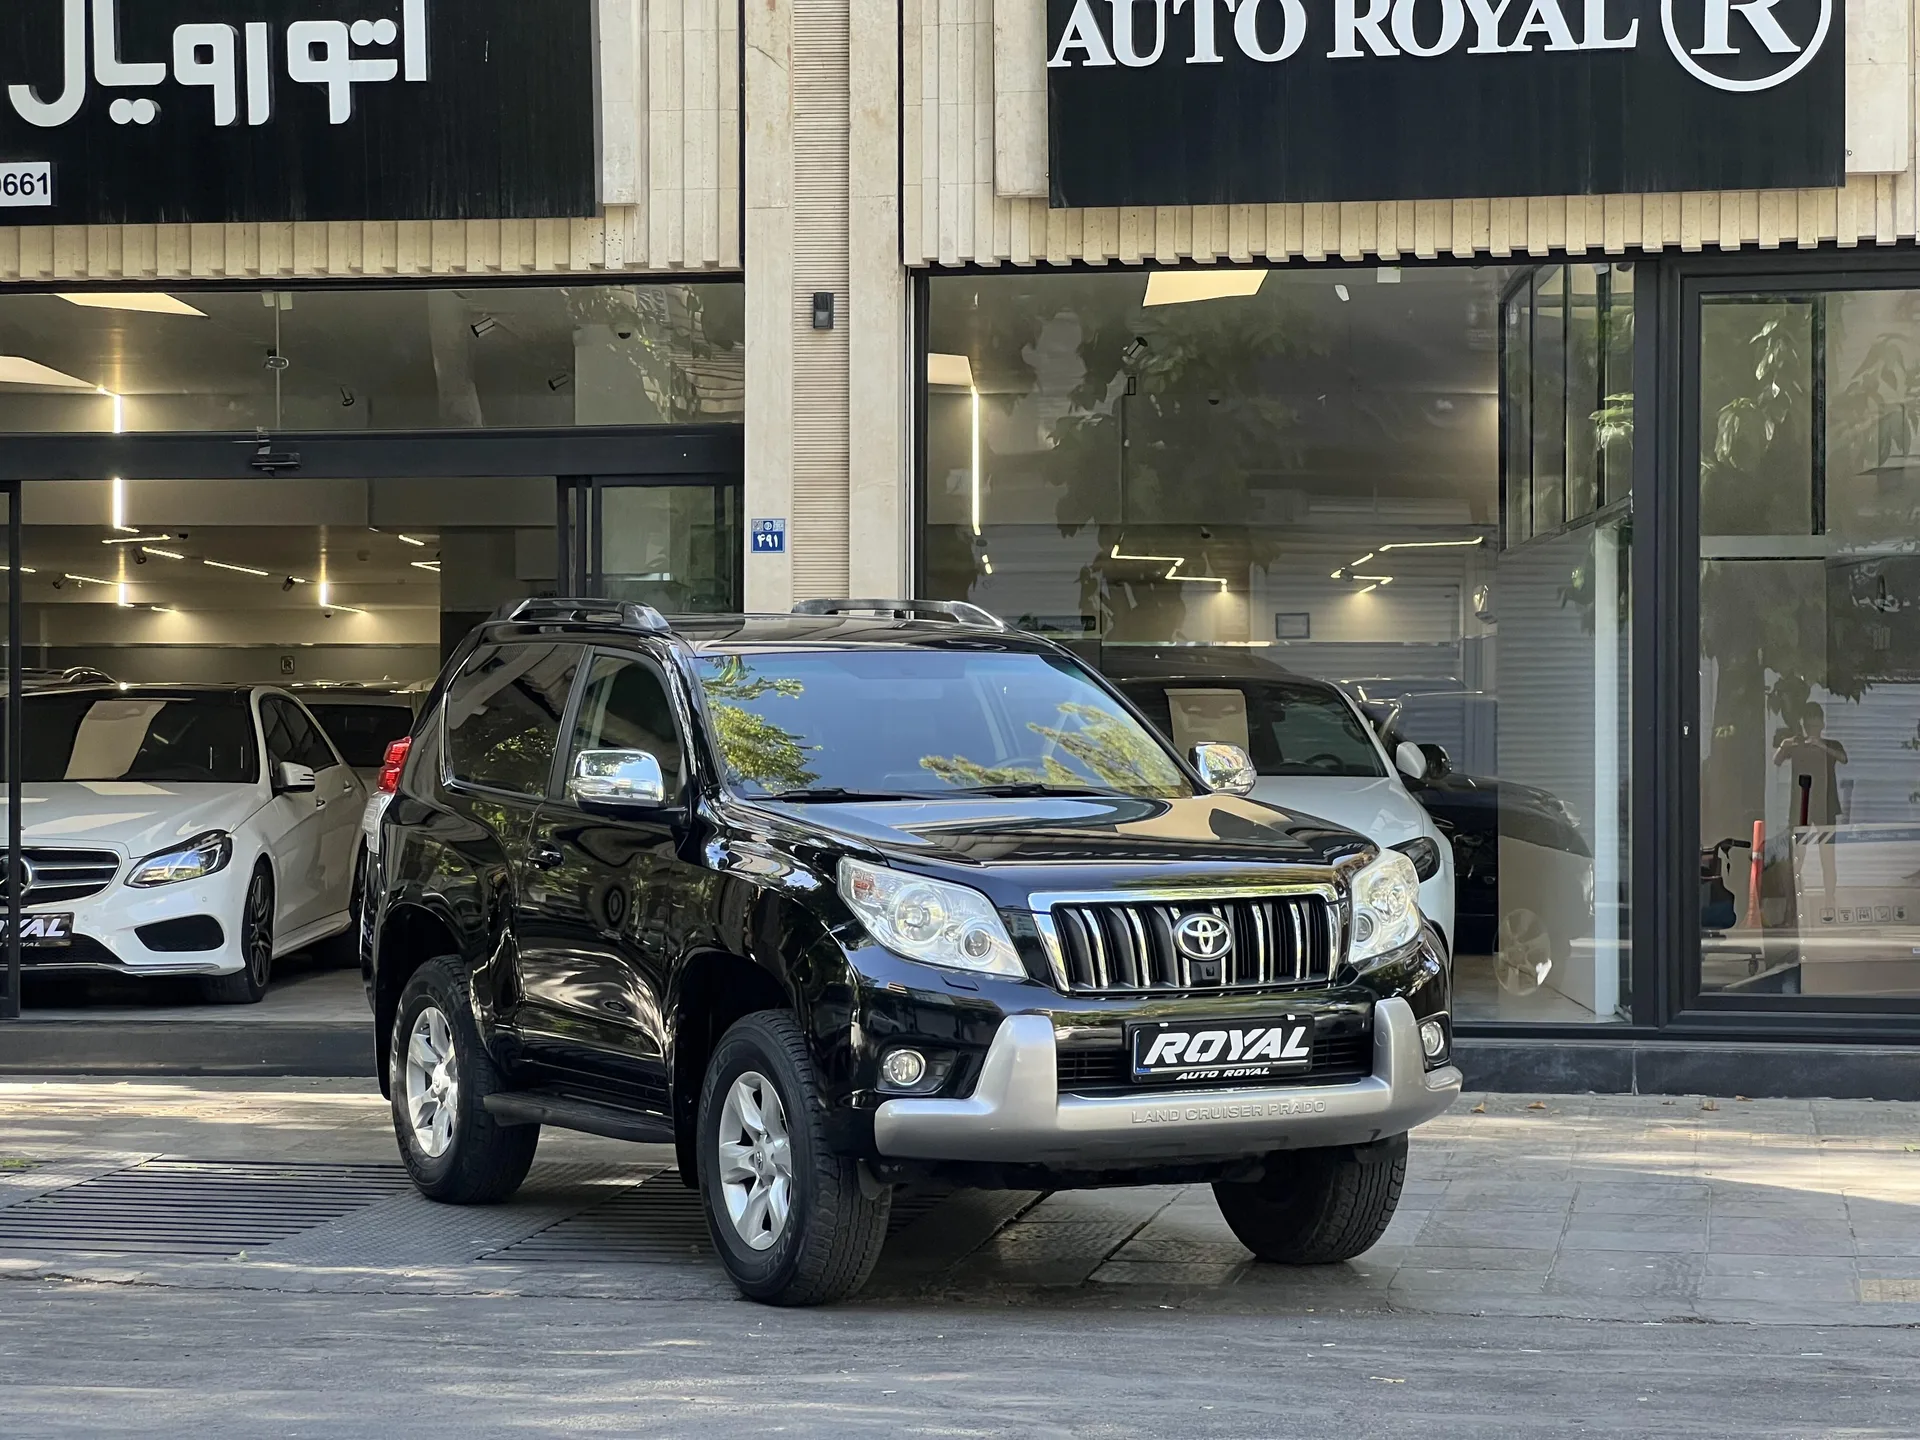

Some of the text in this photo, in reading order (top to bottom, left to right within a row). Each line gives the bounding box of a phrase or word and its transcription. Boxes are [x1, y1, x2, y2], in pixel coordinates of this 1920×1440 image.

[1047, 0, 1639, 68] AUTO ROYAL
[1690, 0, 1801, 55] R
[287, 0, 428, 125] اتو
[0, 172, 48, 197] 661
[1143, 1026, 1310, 1066] ROYAL
[1176, 1067, 1270, 1081] AUTO ROYAL
[1131, 1100, 1327, 1124] LAND CRUISER PRADO
